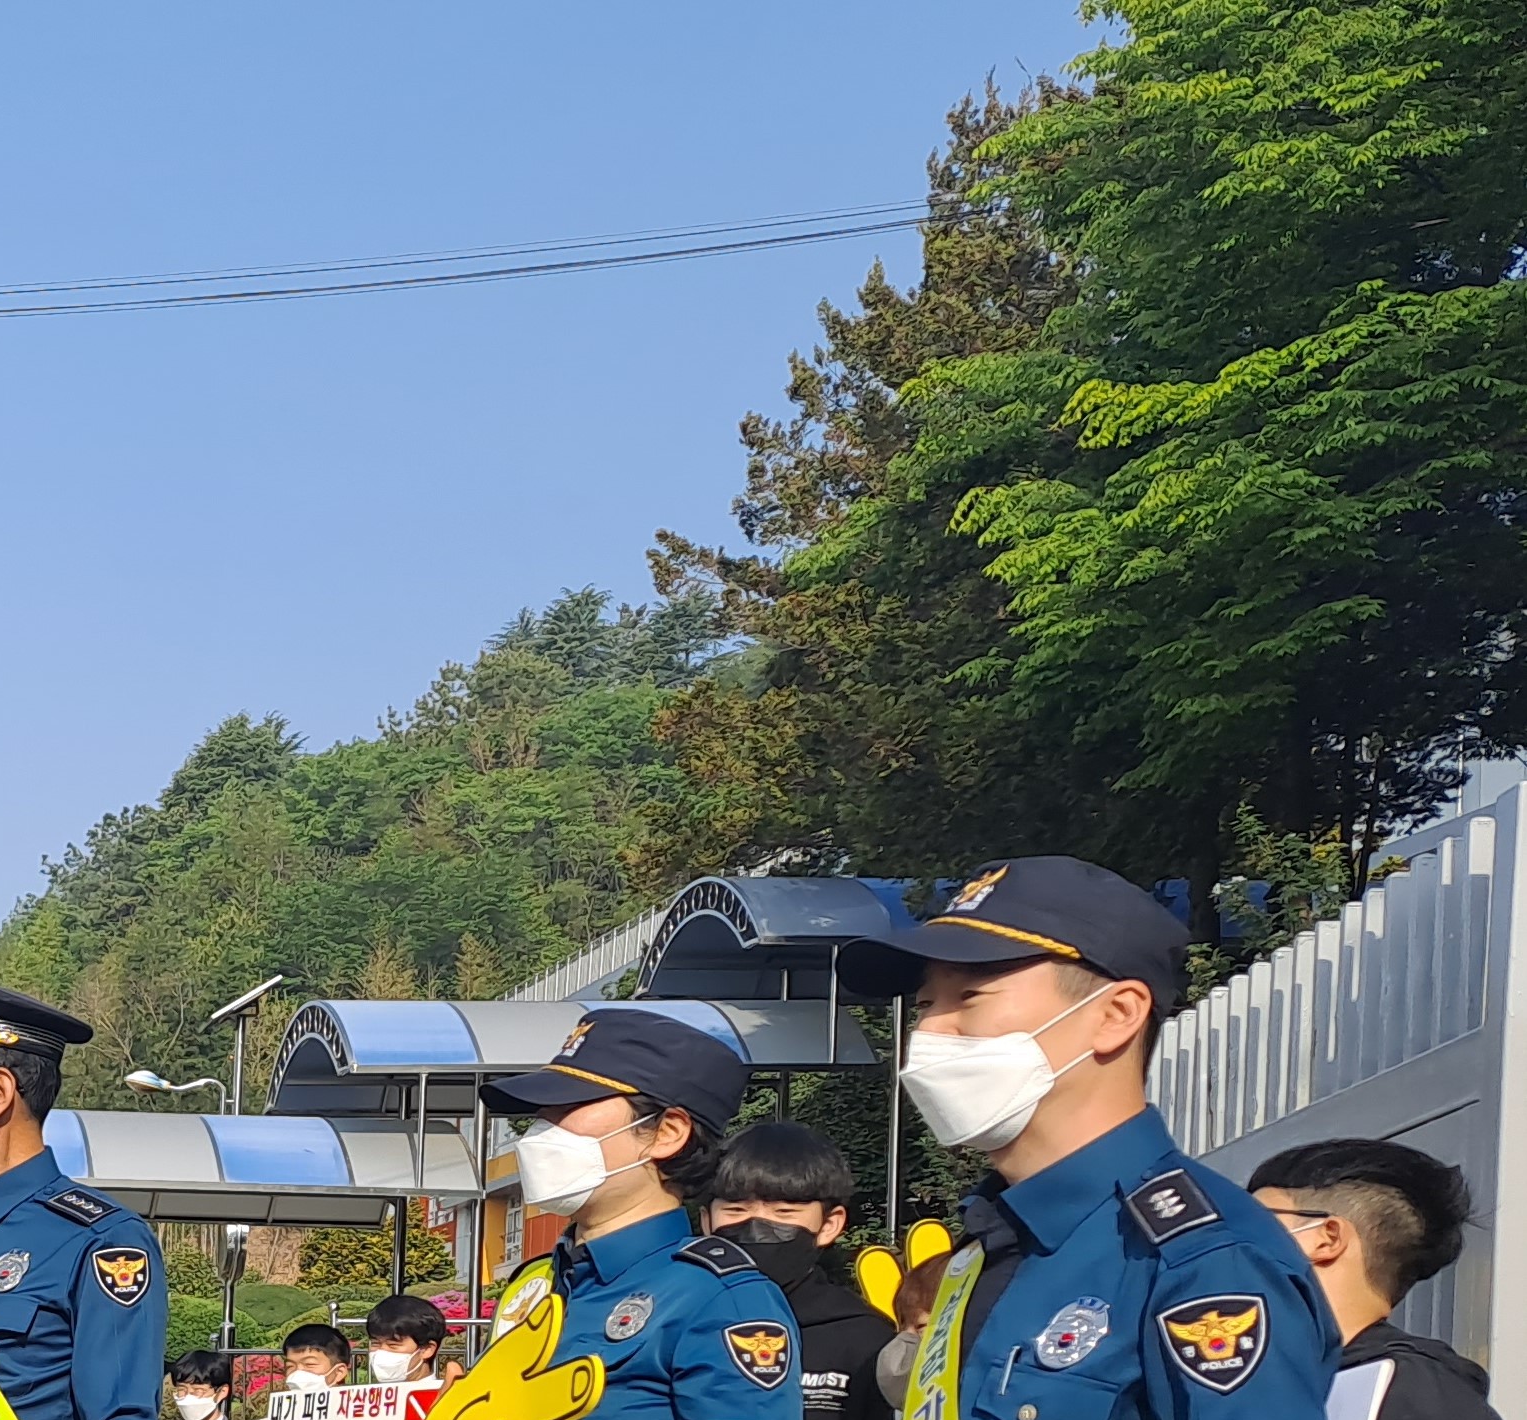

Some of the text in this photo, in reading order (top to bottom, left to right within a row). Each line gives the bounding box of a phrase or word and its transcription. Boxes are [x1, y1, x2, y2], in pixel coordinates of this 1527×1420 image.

[1198, 1357, 1244, 1371] POLICE
[302, 1391, 330, 1420] 피워
[336, 1386, 398, 1419] 자살행위
